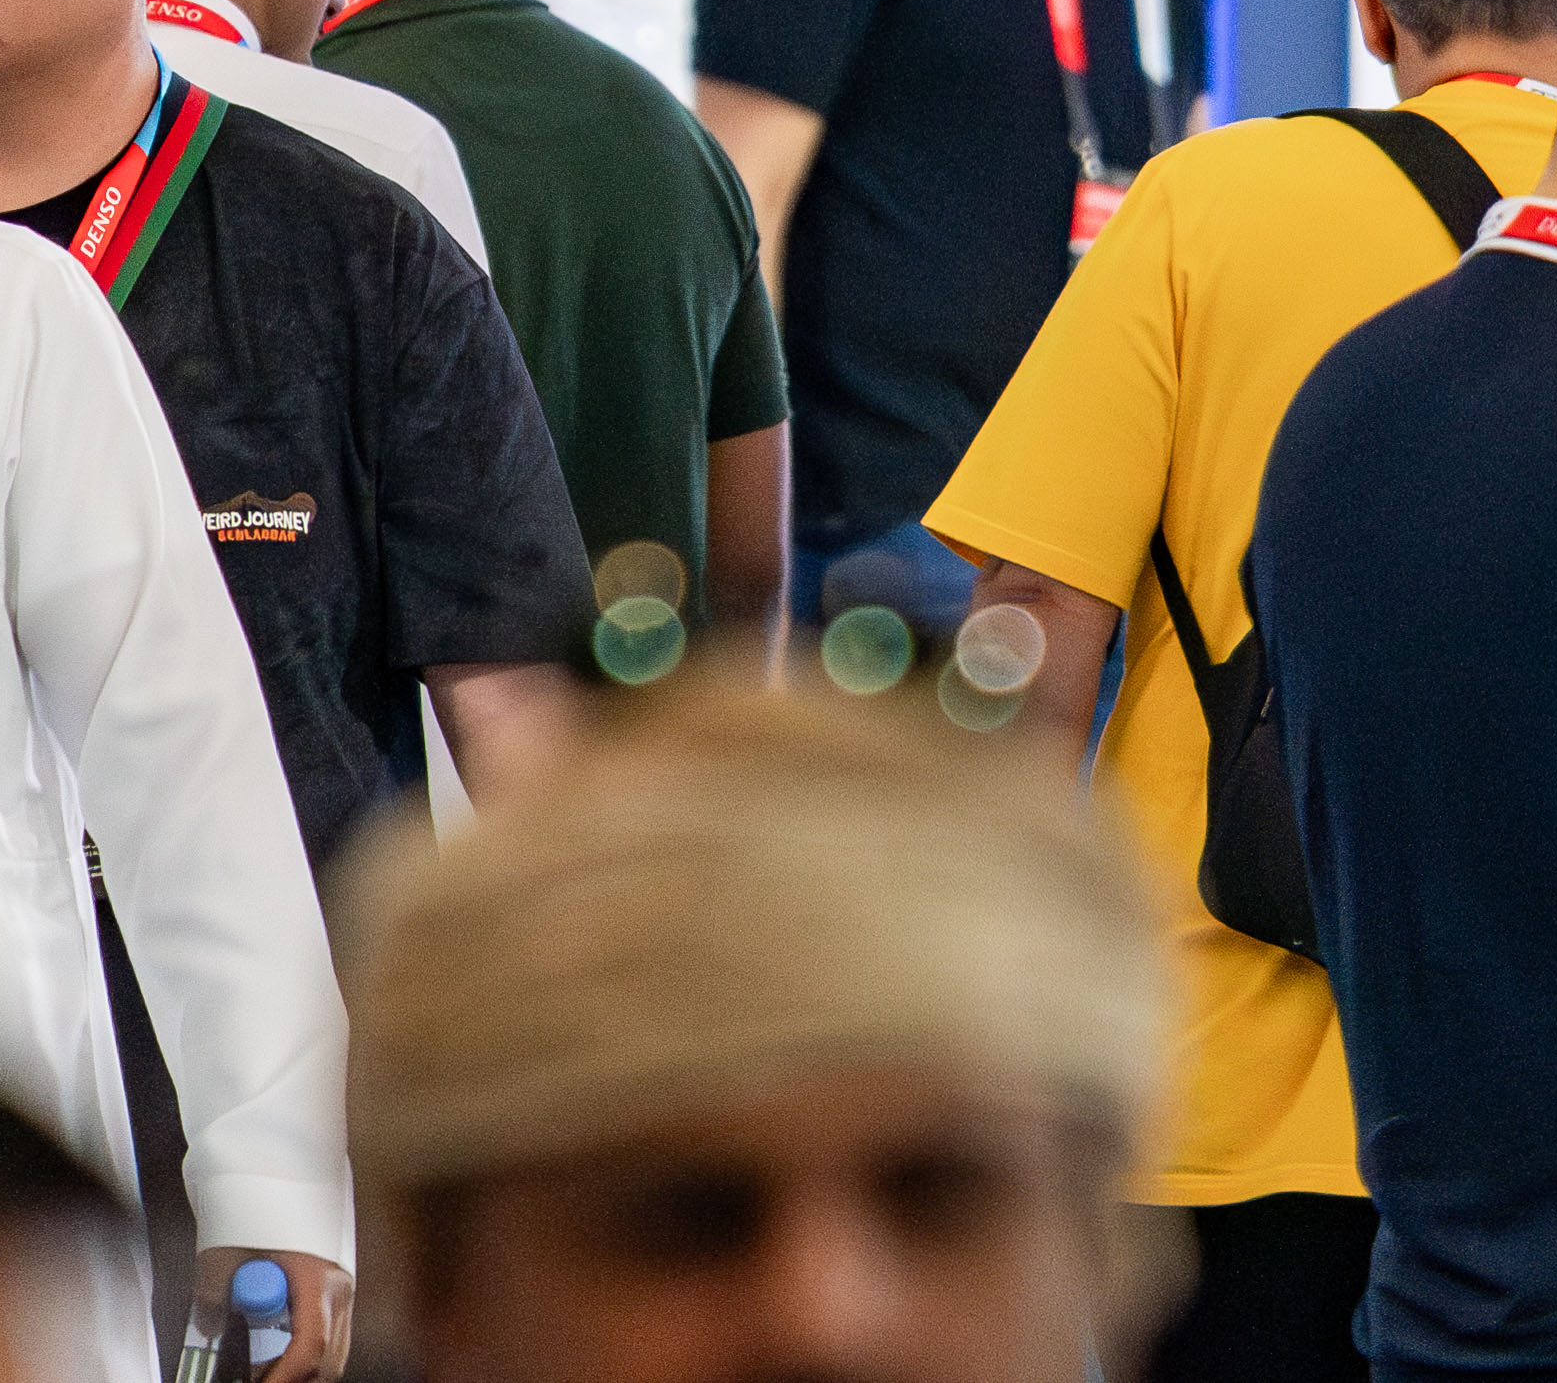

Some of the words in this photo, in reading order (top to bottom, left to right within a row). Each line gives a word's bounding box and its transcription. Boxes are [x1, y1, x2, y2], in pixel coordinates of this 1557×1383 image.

[147, 0, 202, 22] ENSO
[79, 184, 124, 259] DENSO
[243, 510, 310, 534] JOURNEY
